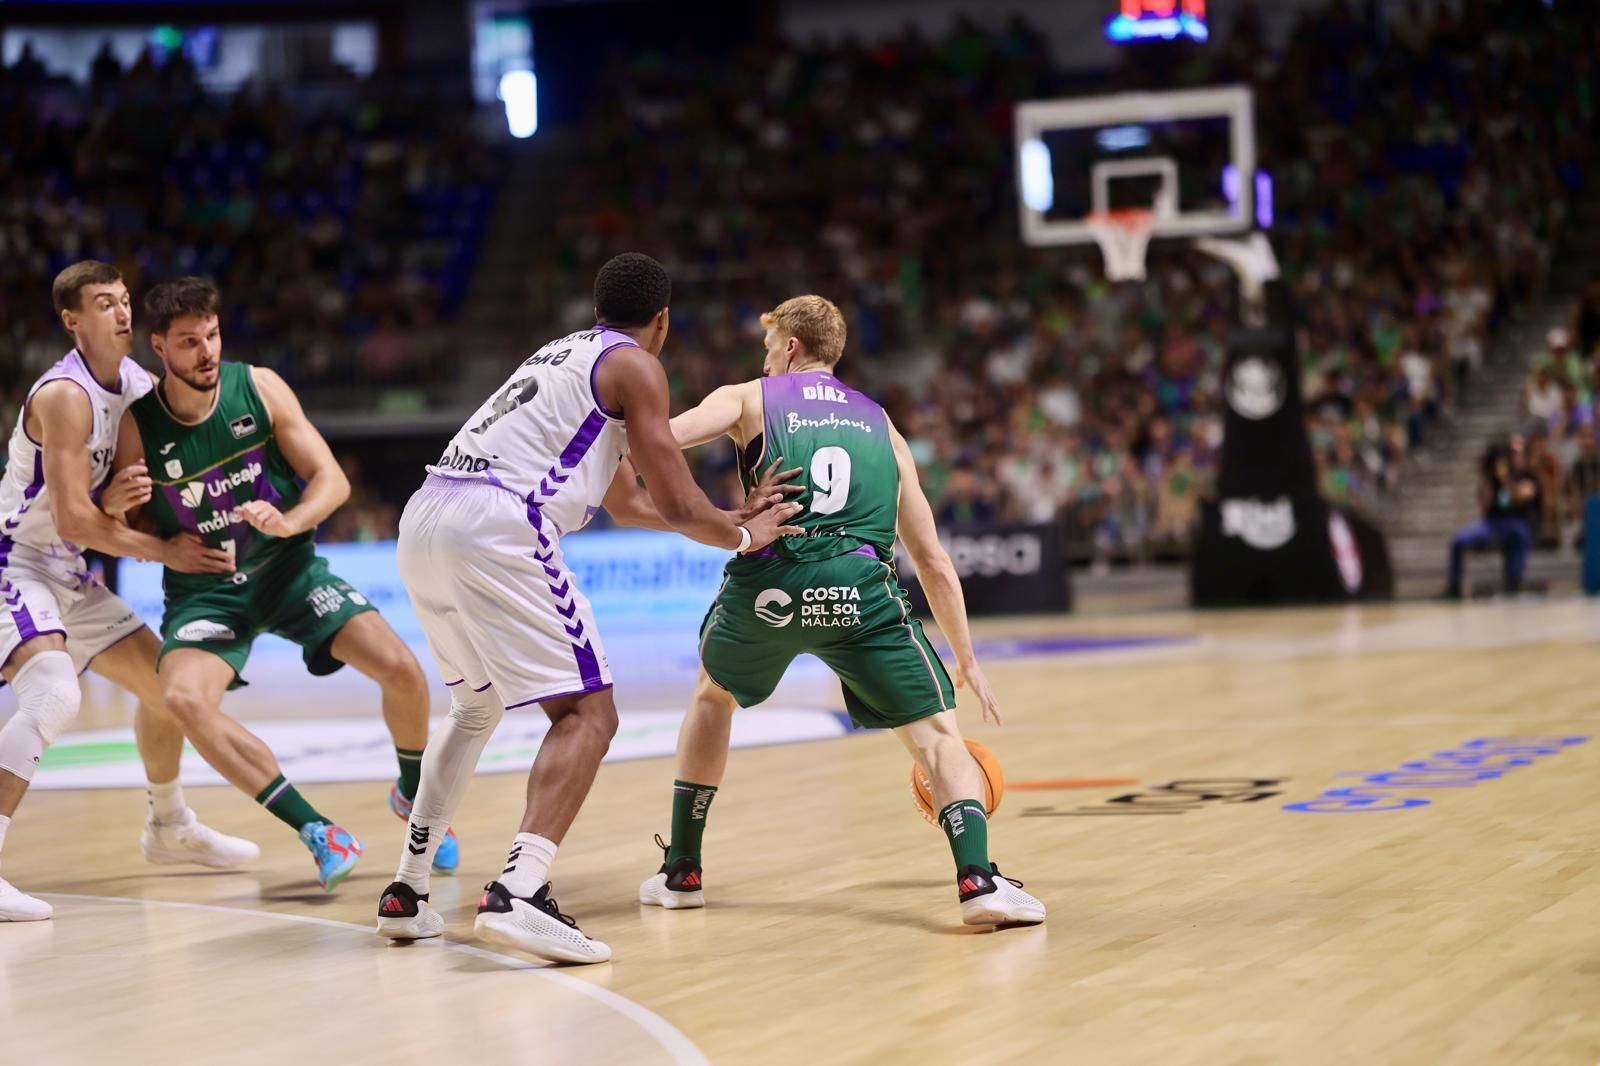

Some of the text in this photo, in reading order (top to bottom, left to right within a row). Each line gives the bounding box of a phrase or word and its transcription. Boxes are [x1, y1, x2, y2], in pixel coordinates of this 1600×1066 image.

[802, 382, 848, 404] DÍAZ
[206, 461, 262, 498] Unicaja
[810, 446, 852, 515] 9
[802, 587, 861, 602] COSTA
[801, 605, 829, 616] DEL
[832, 604, 861, 615] SOL
[801, 615, 861, 628] MÁLAGA
